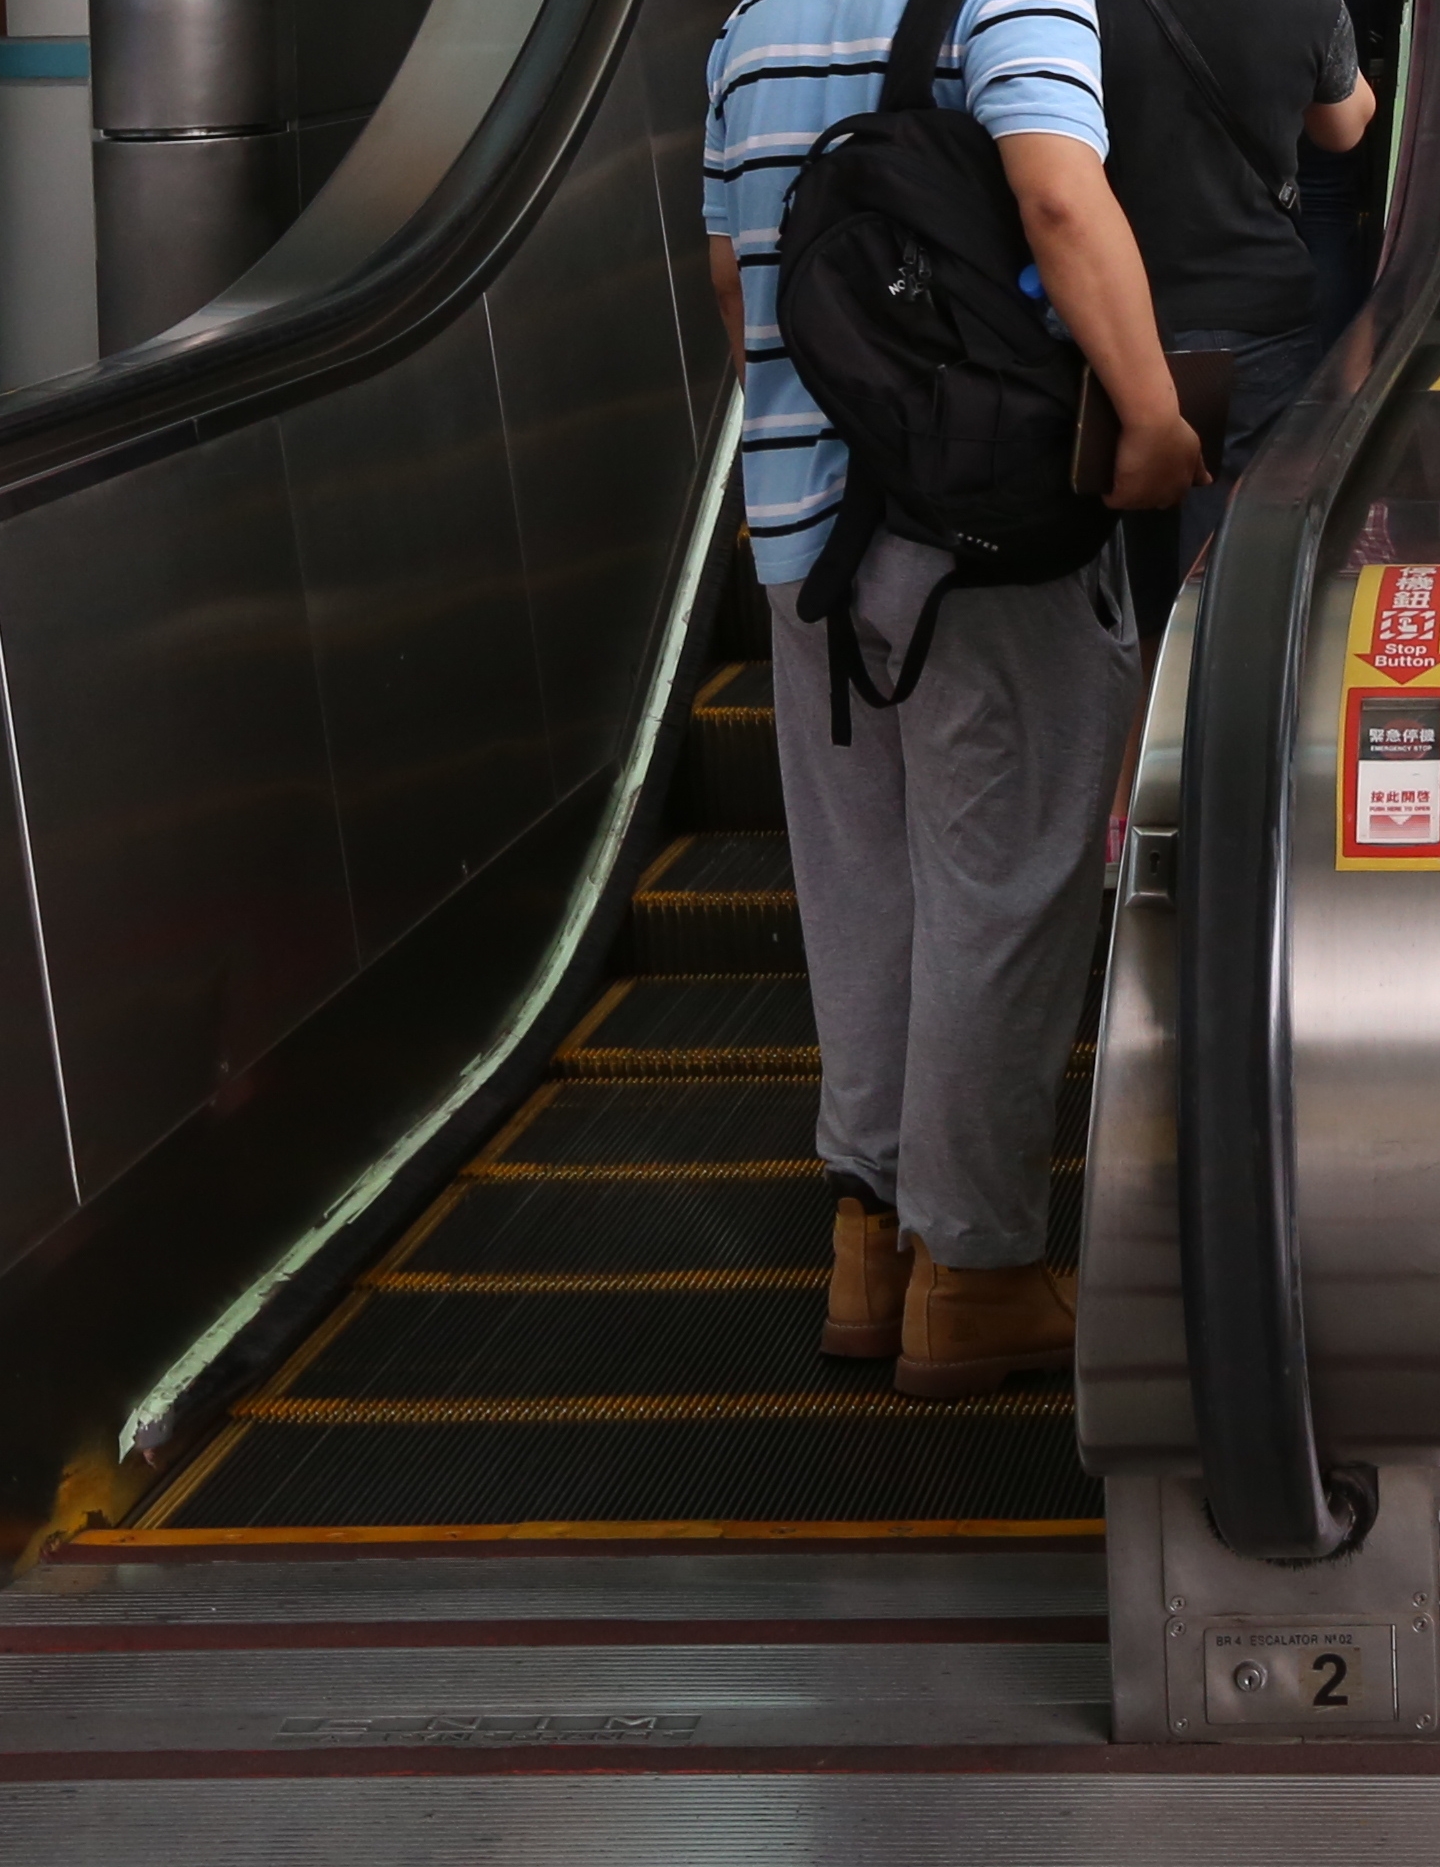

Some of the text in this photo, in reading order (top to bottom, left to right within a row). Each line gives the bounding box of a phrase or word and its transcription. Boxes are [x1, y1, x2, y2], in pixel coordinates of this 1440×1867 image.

[1385, 644, 1427, 657] Stop
[1375, 655, 1435, 667] Button
[1369, 728, 1436, 743] 緊急停機
[1216, 1636, 1231, 1646] BR
[1235, 1636, 1242, 1645] 4
[1250, 1635, 1318, 1646] ESCALATOR
[1312, 1653, 1348, 1706] 2
